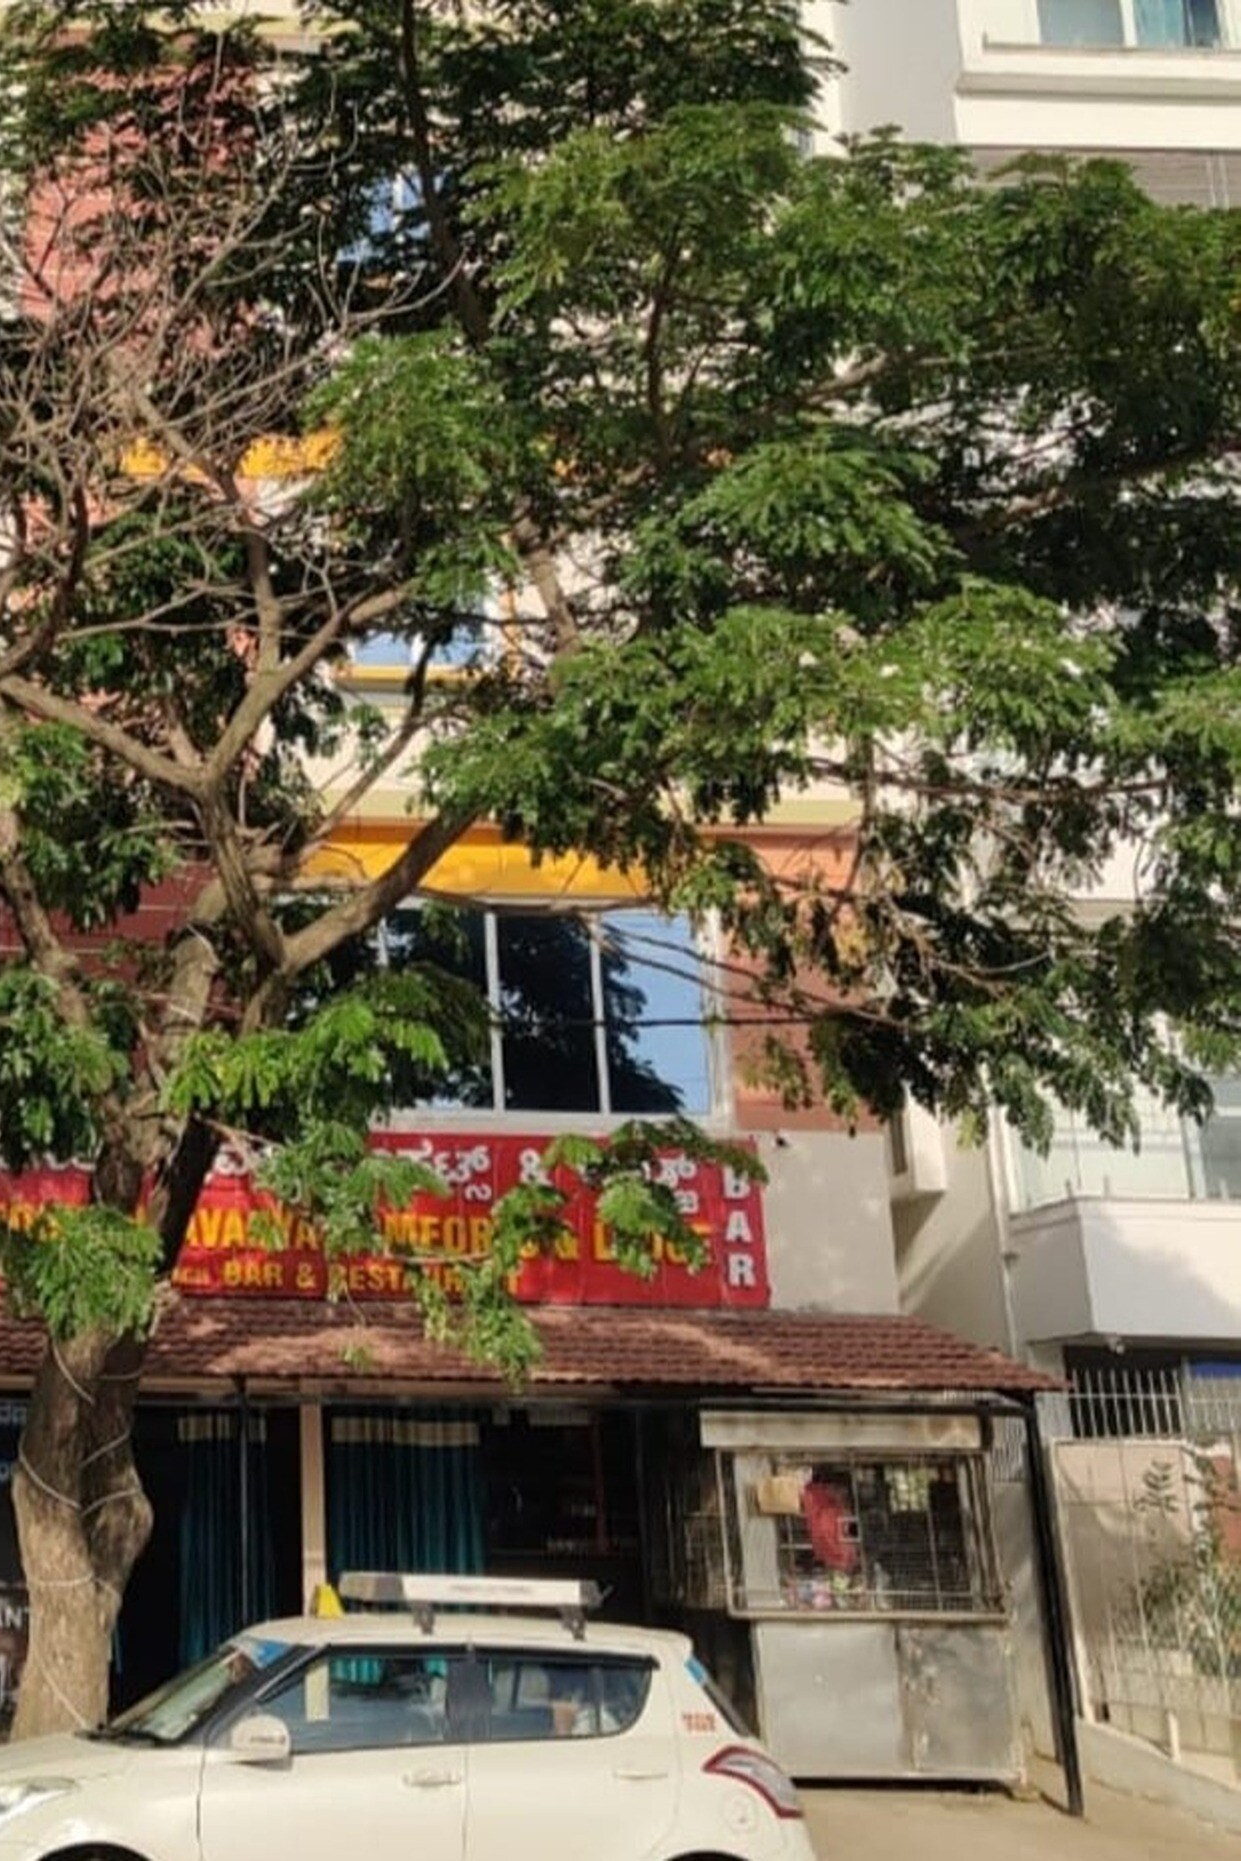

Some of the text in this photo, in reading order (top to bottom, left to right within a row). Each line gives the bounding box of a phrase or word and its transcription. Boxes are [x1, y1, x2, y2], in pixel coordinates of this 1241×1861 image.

[723, 1162, 758, 1287] BAR
[222, 1256, 285, 1288] BAR
[295, 1261, 318, 1290] &
